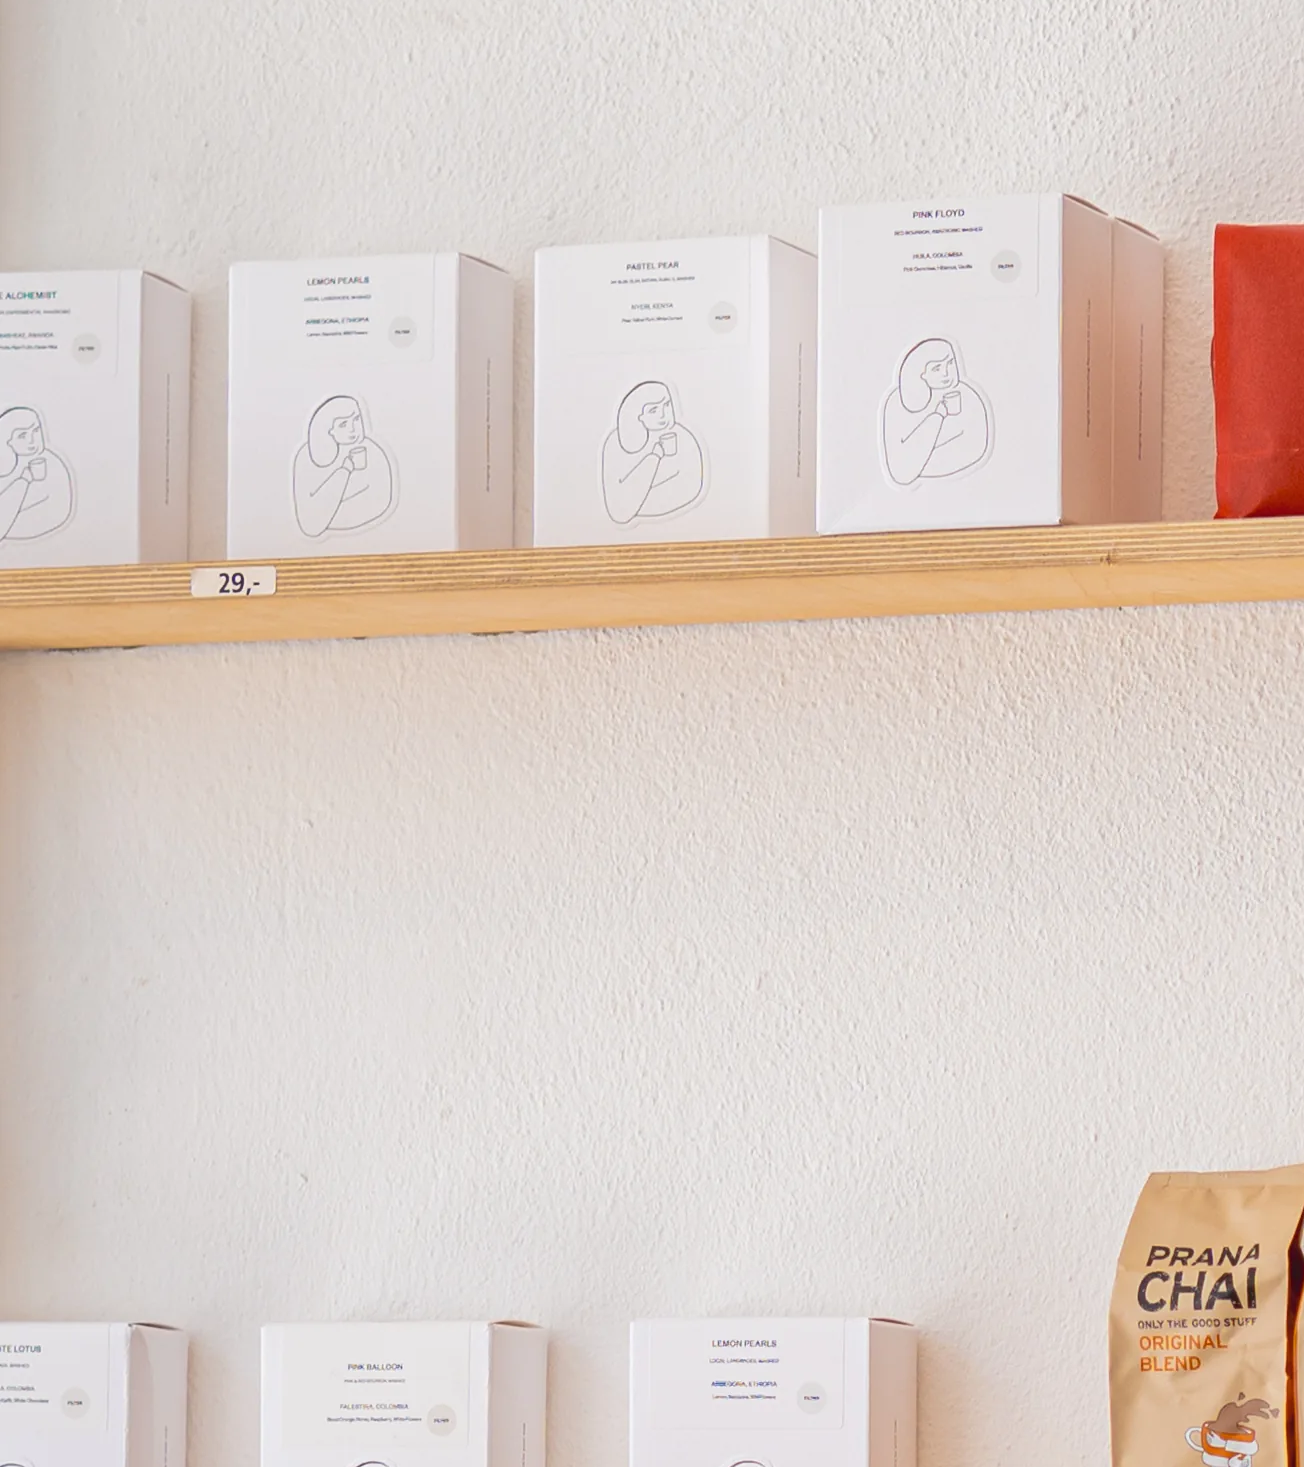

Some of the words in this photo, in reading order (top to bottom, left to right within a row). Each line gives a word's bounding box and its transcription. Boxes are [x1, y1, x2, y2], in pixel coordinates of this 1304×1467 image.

[913, 210, 933, 219] PINK
[935, 208, 965, 218] FLOYD
[626, 263, 656, 271] PASTEL
[658, 261, 679, 270] PEAR
[307, 278, 336, 286] LEMON
[337, 276, 370, 285] PEARLS
[5, 290, 57, 300] ALCHEMIST
[219, 572, 260, 595] 29,-
[1146, 1243, 1260, 1267] PRANA
[1137, 1267, 1257, 1312] CHAI
[1138, 1320, 1164, 1329] ONLY
[1167, 1319, 1188, 1328] THE
[1192, 1318, 1220, 1327] GOOD
[1224, 1317, 1257, 1327] STUFF
[1139, 1333, 1228, 1350] ORIGINAL
[14, 1345, 41, 1353] LOTUS
[366, 1363, 403, 1371] BALLOON
[1140, 1356, 1201, 1372] BLEND
